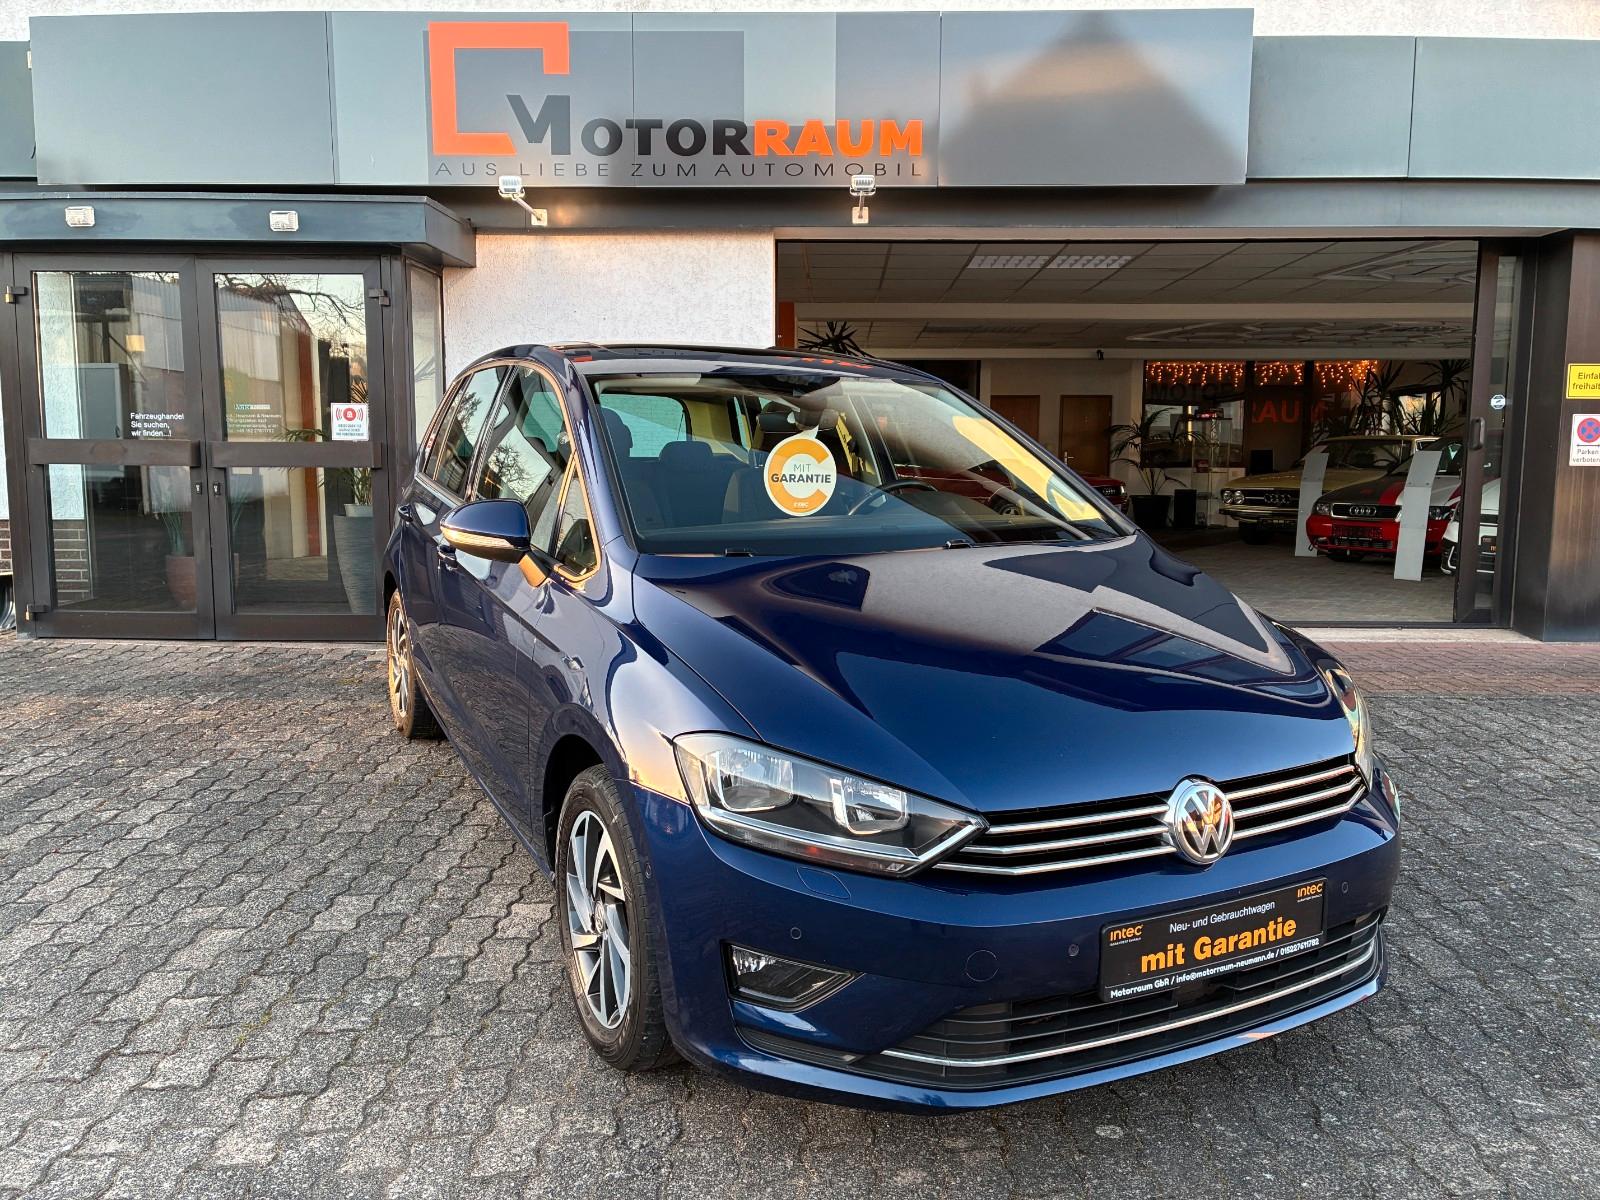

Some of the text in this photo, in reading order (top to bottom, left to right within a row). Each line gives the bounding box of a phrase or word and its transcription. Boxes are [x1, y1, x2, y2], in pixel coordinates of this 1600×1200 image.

[435, 162, 921, 177] AUS LIEBE ZUM AUTOMOBIL
[130, 412, 184, 421] Fahrzeughandel
[143, 421, 170, 429] suchen,
[793, 463, 812, 473] MIT
[771, 473, 831, 483] GARANTIE
[1169, 901, 1275, 934] Neu- und Gebrauchtwagen
[1141, 917, 1297, 973] mit Garantie
[1110, 983, 1153, 999] Motorraum
[1154, 977, 1170, 989] GbR
[1176, 950, 1275, 984] info@motorraum-neumann.de
